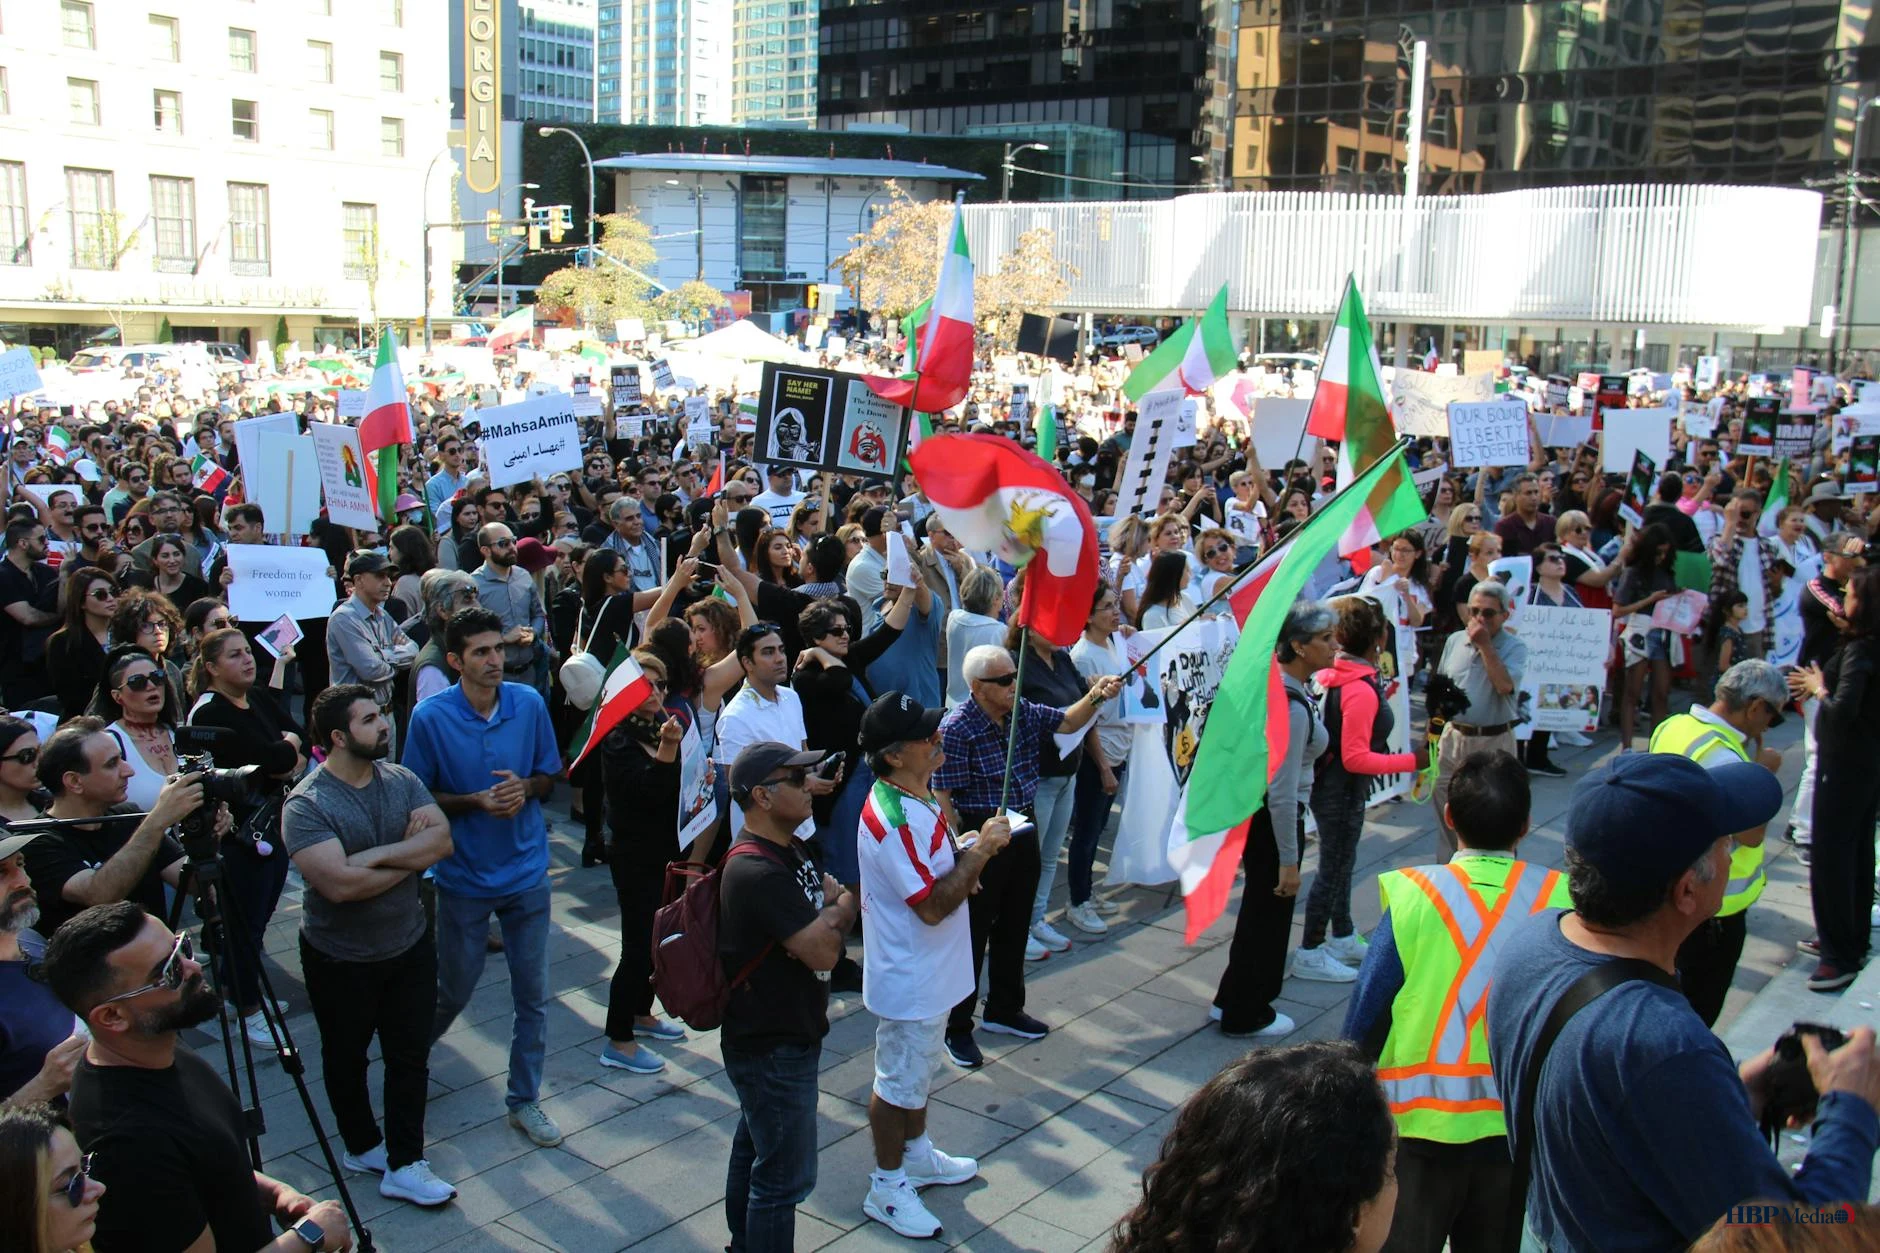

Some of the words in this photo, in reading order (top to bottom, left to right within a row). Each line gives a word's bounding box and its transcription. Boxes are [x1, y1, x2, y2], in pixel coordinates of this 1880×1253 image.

[612, 374, 639, 386] IRAN
[786, 379, 801, 387] SAY
[802, 381, 818, 389] HER
[786, 386, 812, 396] NAME!
[852, 396, 865, 405] The
[867, 399, 897, 410] Internet
[866, 409, 887, 419] Down
[1454, 407, 1483, 425] OUR
[481, 409, 578, 442] #MahsaAmini
[1775, 424, 1813, 439] IRAN
[1456, 423, 1524, 445] LIBERTY
[1458, 445, 1475, 463] IS
[1476, 440, 1527, 460] TOGETHE
[327, 496, 348, 509] ZHINA
[252, 569, 296, 580] Freedom
[299, 570, 313, 581] for
[265, 590, 302, 598] women
[1178, 650, 1211, 671] Down
